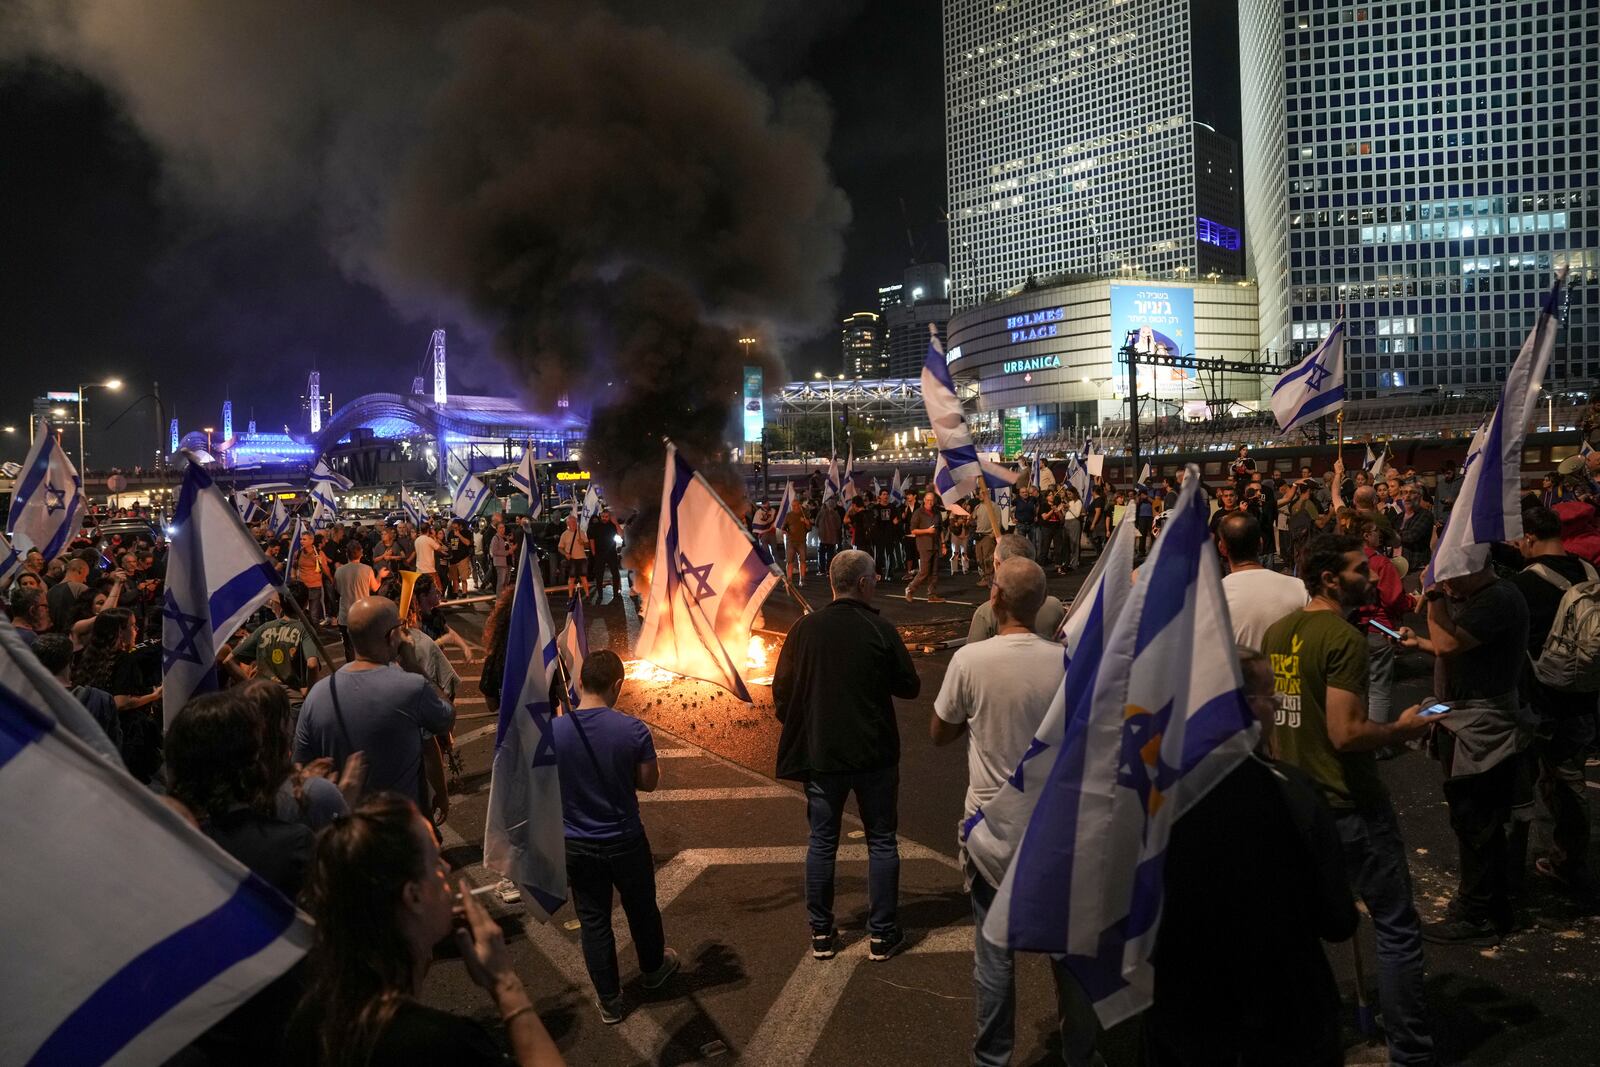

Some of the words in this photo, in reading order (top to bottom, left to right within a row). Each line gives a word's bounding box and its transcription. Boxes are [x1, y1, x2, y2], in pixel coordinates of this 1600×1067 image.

[1007, 308, 1064, 329] HOLMES
[1011, 324, 1057, 343] PLACE
[1004, 355, 1060, 373] URBANICA
